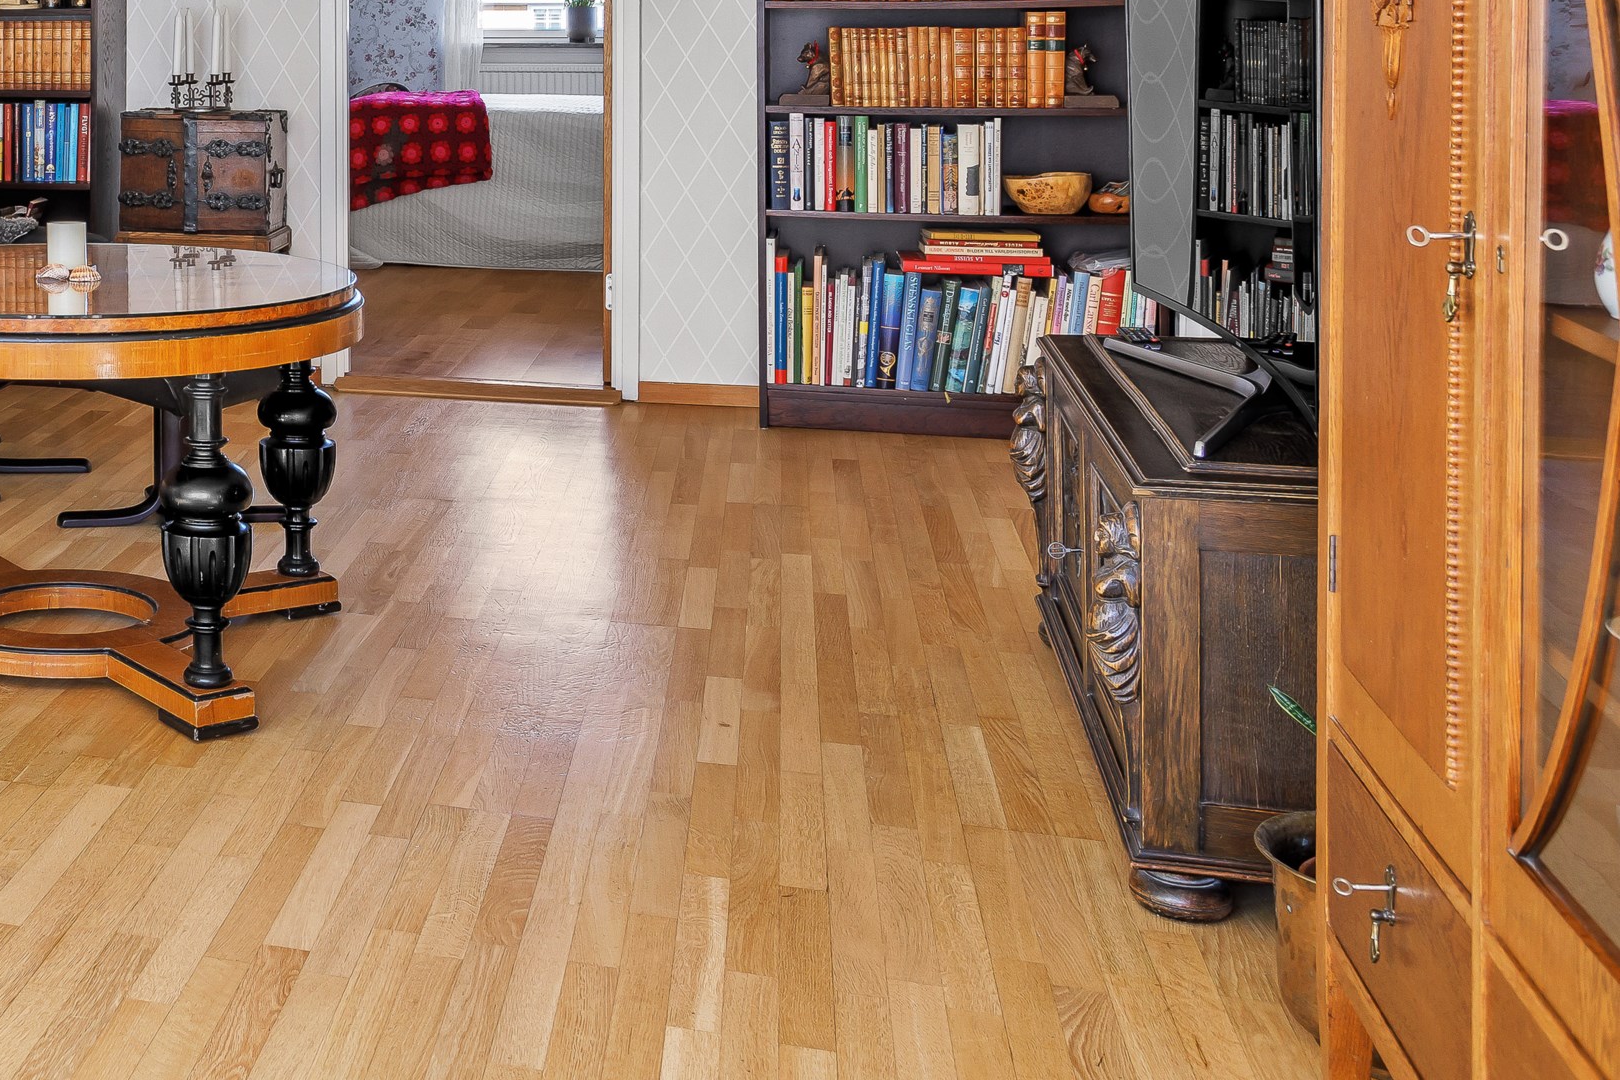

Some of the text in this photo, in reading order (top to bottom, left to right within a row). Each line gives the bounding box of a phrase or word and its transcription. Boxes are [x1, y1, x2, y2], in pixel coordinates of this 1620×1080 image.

[904, 277, 918, 350] SVENSKT GLAS
[1085, 284, 1100, 334] Carl Larsso
